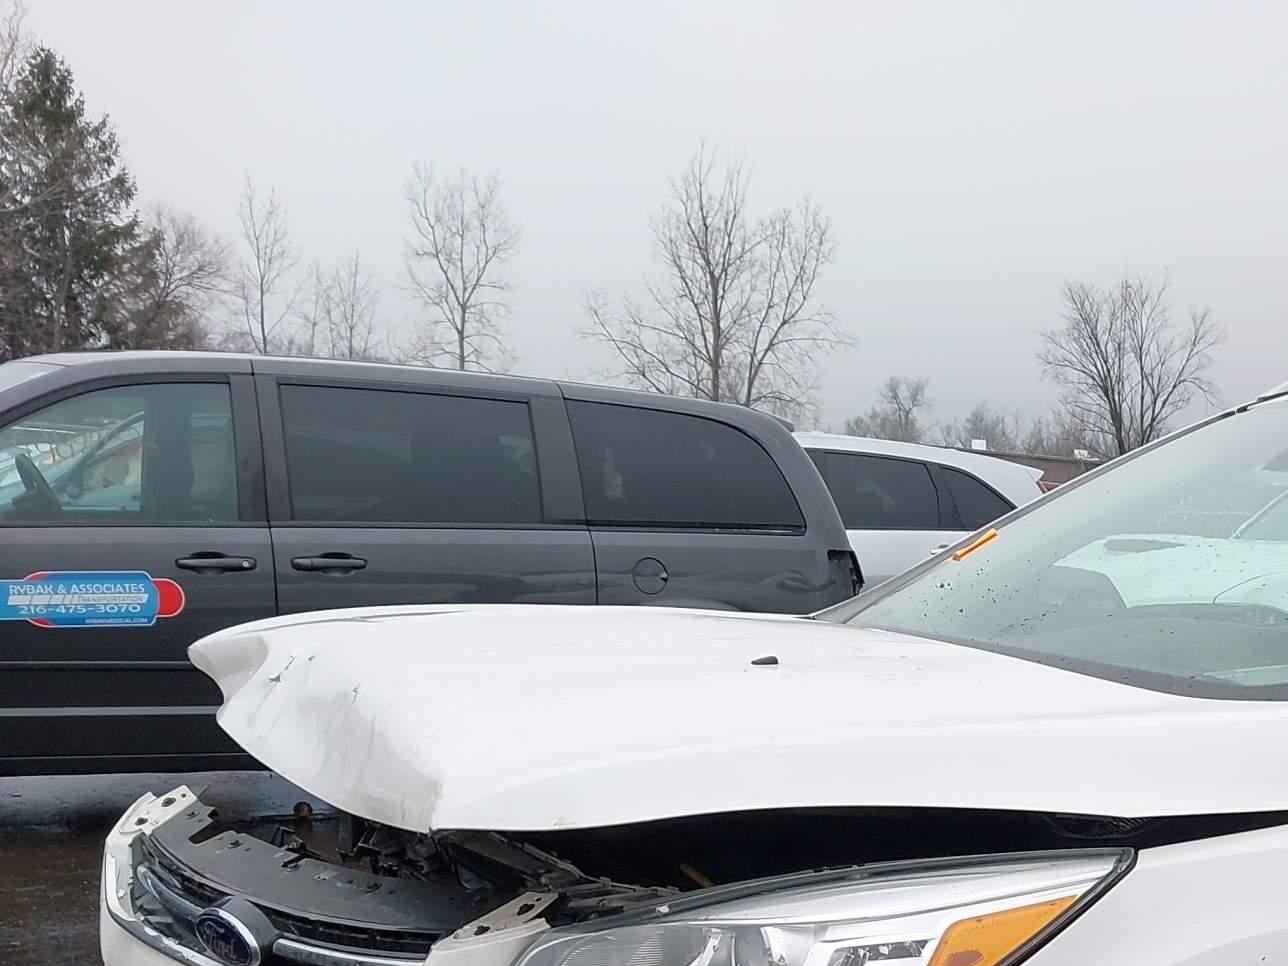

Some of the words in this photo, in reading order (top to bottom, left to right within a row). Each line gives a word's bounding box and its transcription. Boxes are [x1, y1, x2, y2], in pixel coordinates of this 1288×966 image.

[9, 584, 53, 594] RYBAK
[57, 584, 67, 594] &
[70, 583, 145, 594] ASSOCIATES
[19, 604, 141, 614] 216-475-3070
